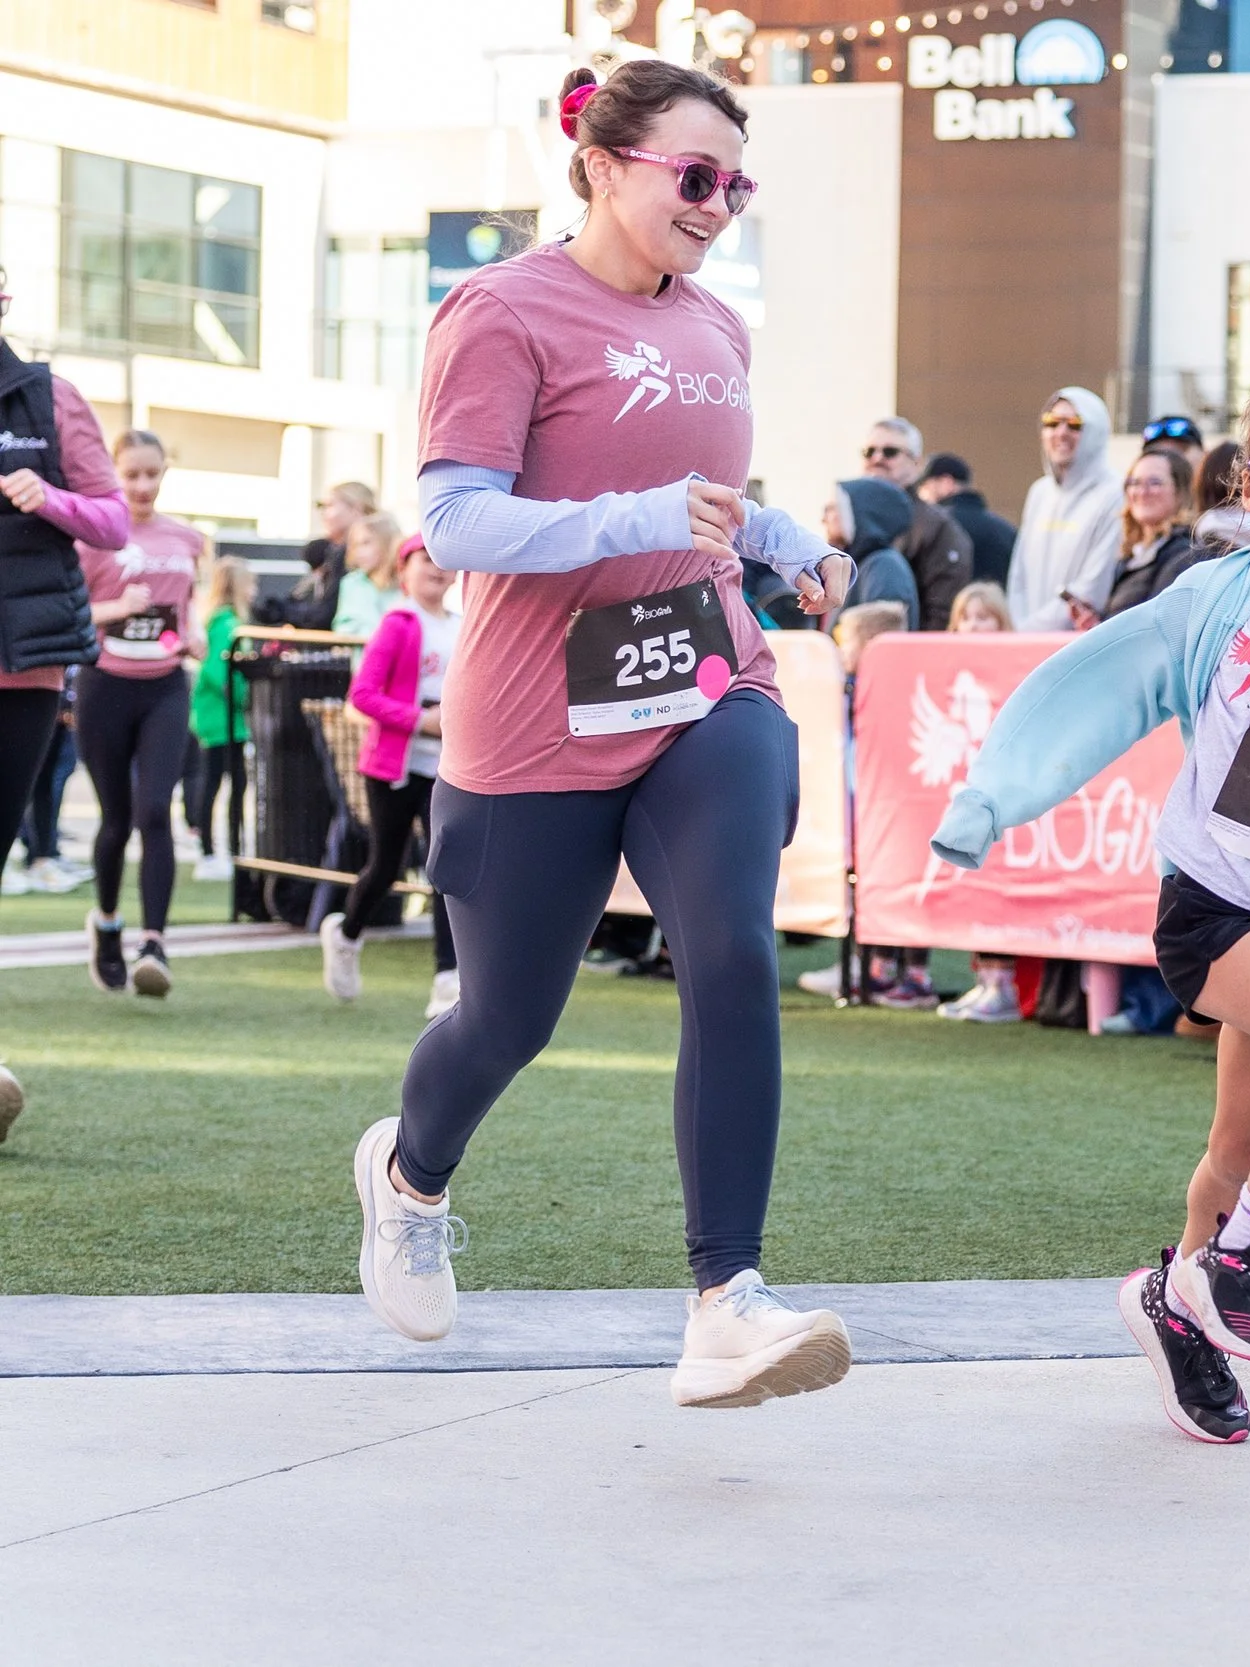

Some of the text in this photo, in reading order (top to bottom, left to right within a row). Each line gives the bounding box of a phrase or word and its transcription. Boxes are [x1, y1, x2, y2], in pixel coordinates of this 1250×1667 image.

[908, 33, 1016, 88] Bell
[933, 87, 1076, 140] Bank
[630, 150, 668, 163] SCHEELS
[615, 629, 697, 687] 255
[656, 705, 671, 715] ND
